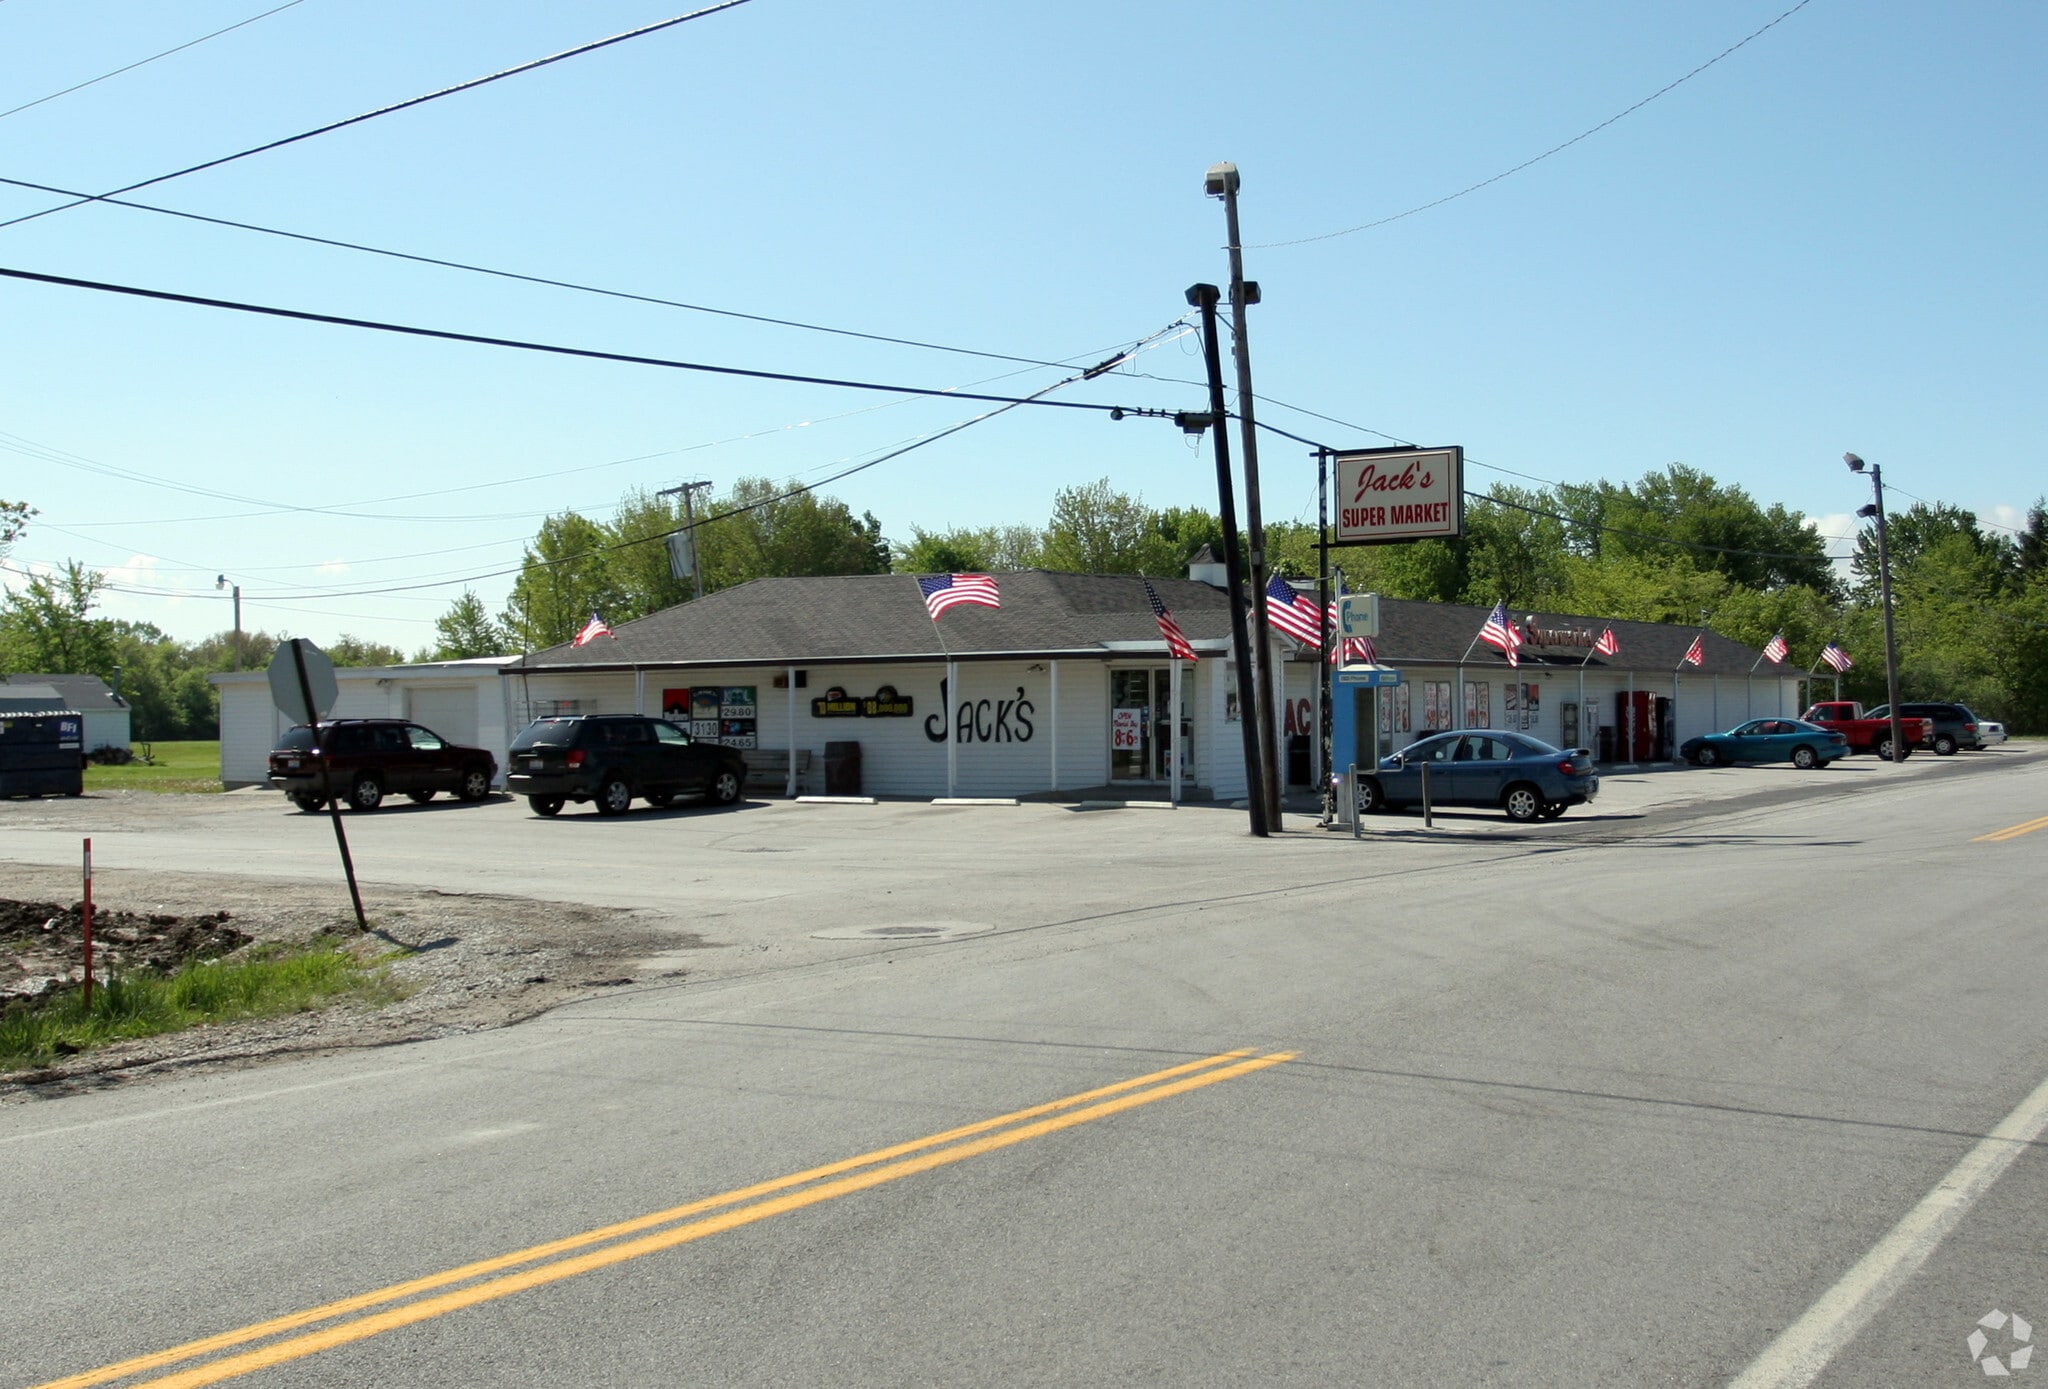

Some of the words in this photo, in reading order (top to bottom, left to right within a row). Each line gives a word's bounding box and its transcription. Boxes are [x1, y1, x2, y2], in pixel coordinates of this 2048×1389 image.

[1354, 461, 1434, 503] Jack's
[1342, 507, 1386, 528] SUPER
[1391, 502, 1448, 525] MARKET
[1347, 610, 1368, 622] Phone
[60, 721, 77, 733] BFI
